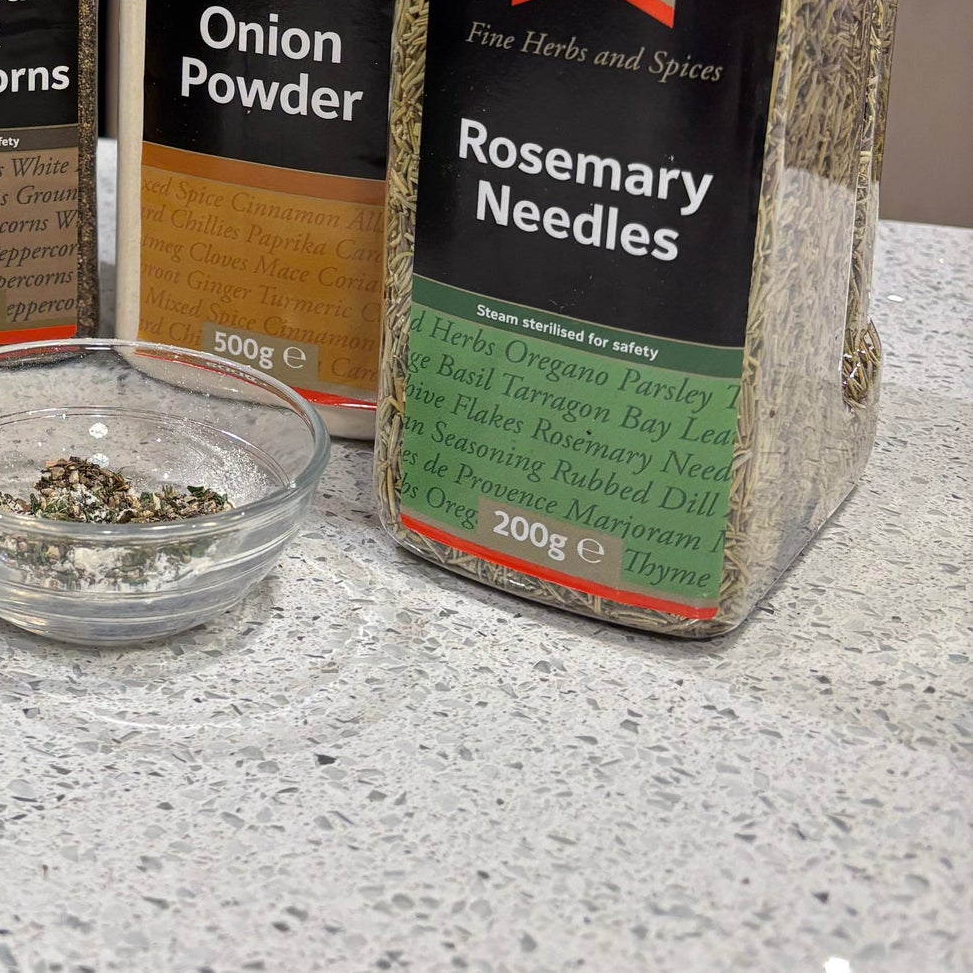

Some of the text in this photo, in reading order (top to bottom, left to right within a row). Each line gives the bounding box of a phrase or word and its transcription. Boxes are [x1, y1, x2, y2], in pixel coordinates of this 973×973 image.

[200, 5, 342, 63] Onion
[466, 21, 724, 83] Fine Herbs and Spices
[181, 56, 364, 121] Powder
[11, 155, 69, 178] White
[458, 118, 713, 216] Rosemary
[170, 209, 239, 239] Chillies
[246, 224, 326, 256] Paprika
[176, 182, 224, 207] Spice
[232, 193, 340, 227] Cinnamon
[476, 179, 680, 262] Needles
[187, 270, 252, 302] Ginger
[259, 284, 353, 318] Turmeric
[190, 242, 247, 270] Cloves
[253, 258, 309, 282] Mace
[318, 267, 381, 292] Coria
[7, 298, 74, 322] epperco
[145, 287, 374, 352] Mixed Spice Cinnamon
[476, 303, 659, 361] Steam sterilised for safety
[214, 331, 275, 370] 500g
[430, 318, 495, 356] Herbs
[505, 339, 609, 386] Oregano
[618, 368, 713, 413] Parsley
[436, 355, 494, 391] Basil
[502, 372, 611, 423] Tarragon
[622, 405, 672, 442] Bay
[679, 418, 736, 447] Lea
[451, 394, 525, 434] Flakes
[531, 418, 653, 476] Rosemary
[431, 421, 546, 483] Seasoning
[550, 458, 649, 506] Rubbed
[659, 486, 718, 518] Dill
[424, 455, 449, 478] de
[455, 462, 558, 514] Provence
[564, 500, 701, 550] Marjoram
[493, 510, 568, 561] 200g
[624, 548, 711, 588] Thyme
